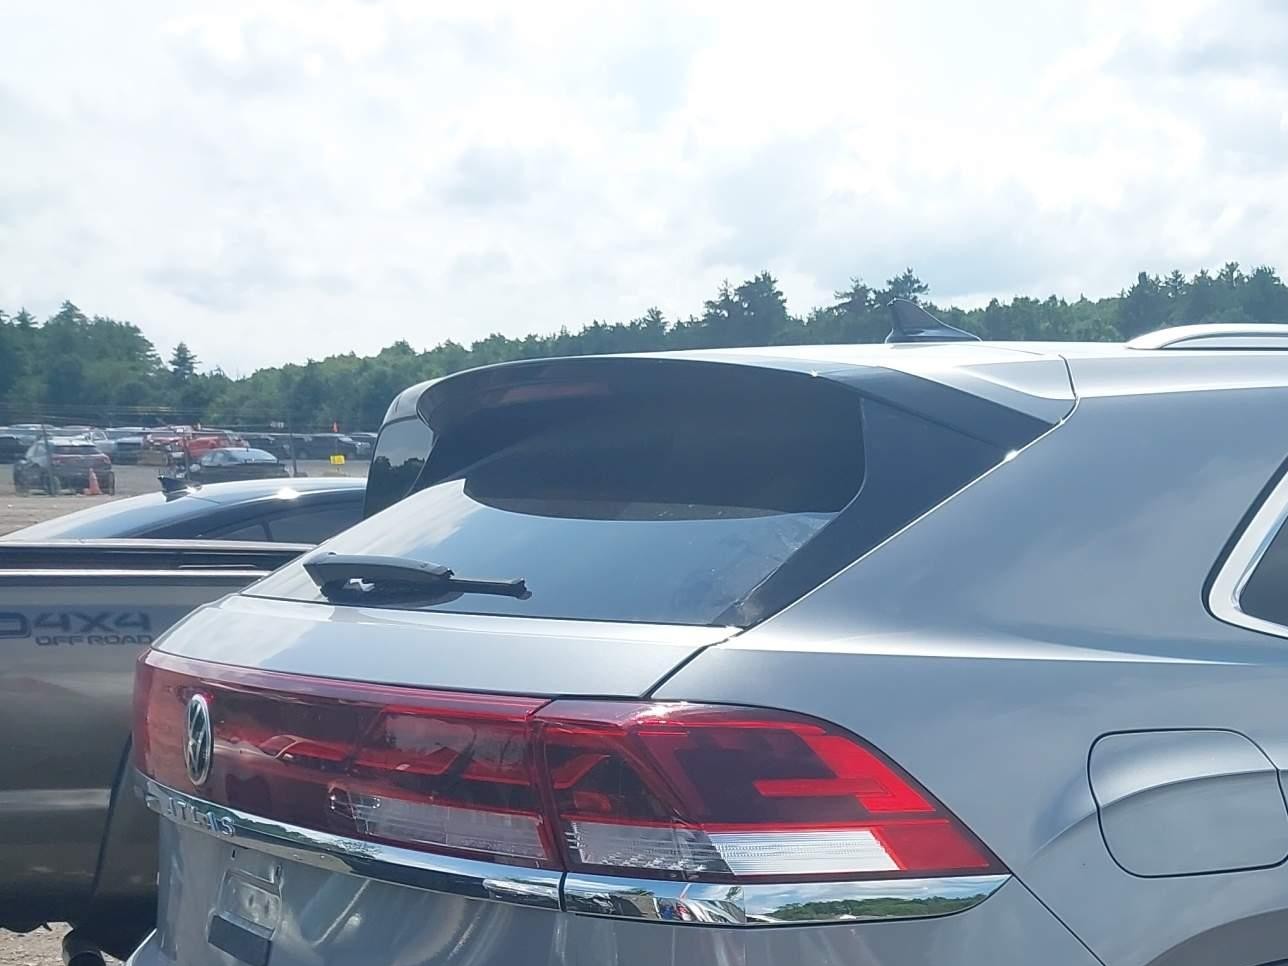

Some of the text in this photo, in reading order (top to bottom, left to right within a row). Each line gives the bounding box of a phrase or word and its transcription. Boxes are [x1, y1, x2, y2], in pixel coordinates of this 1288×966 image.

[35, 634, 152, 646] OFF ROAD
[167, 797, 235, 837] ATLAS
